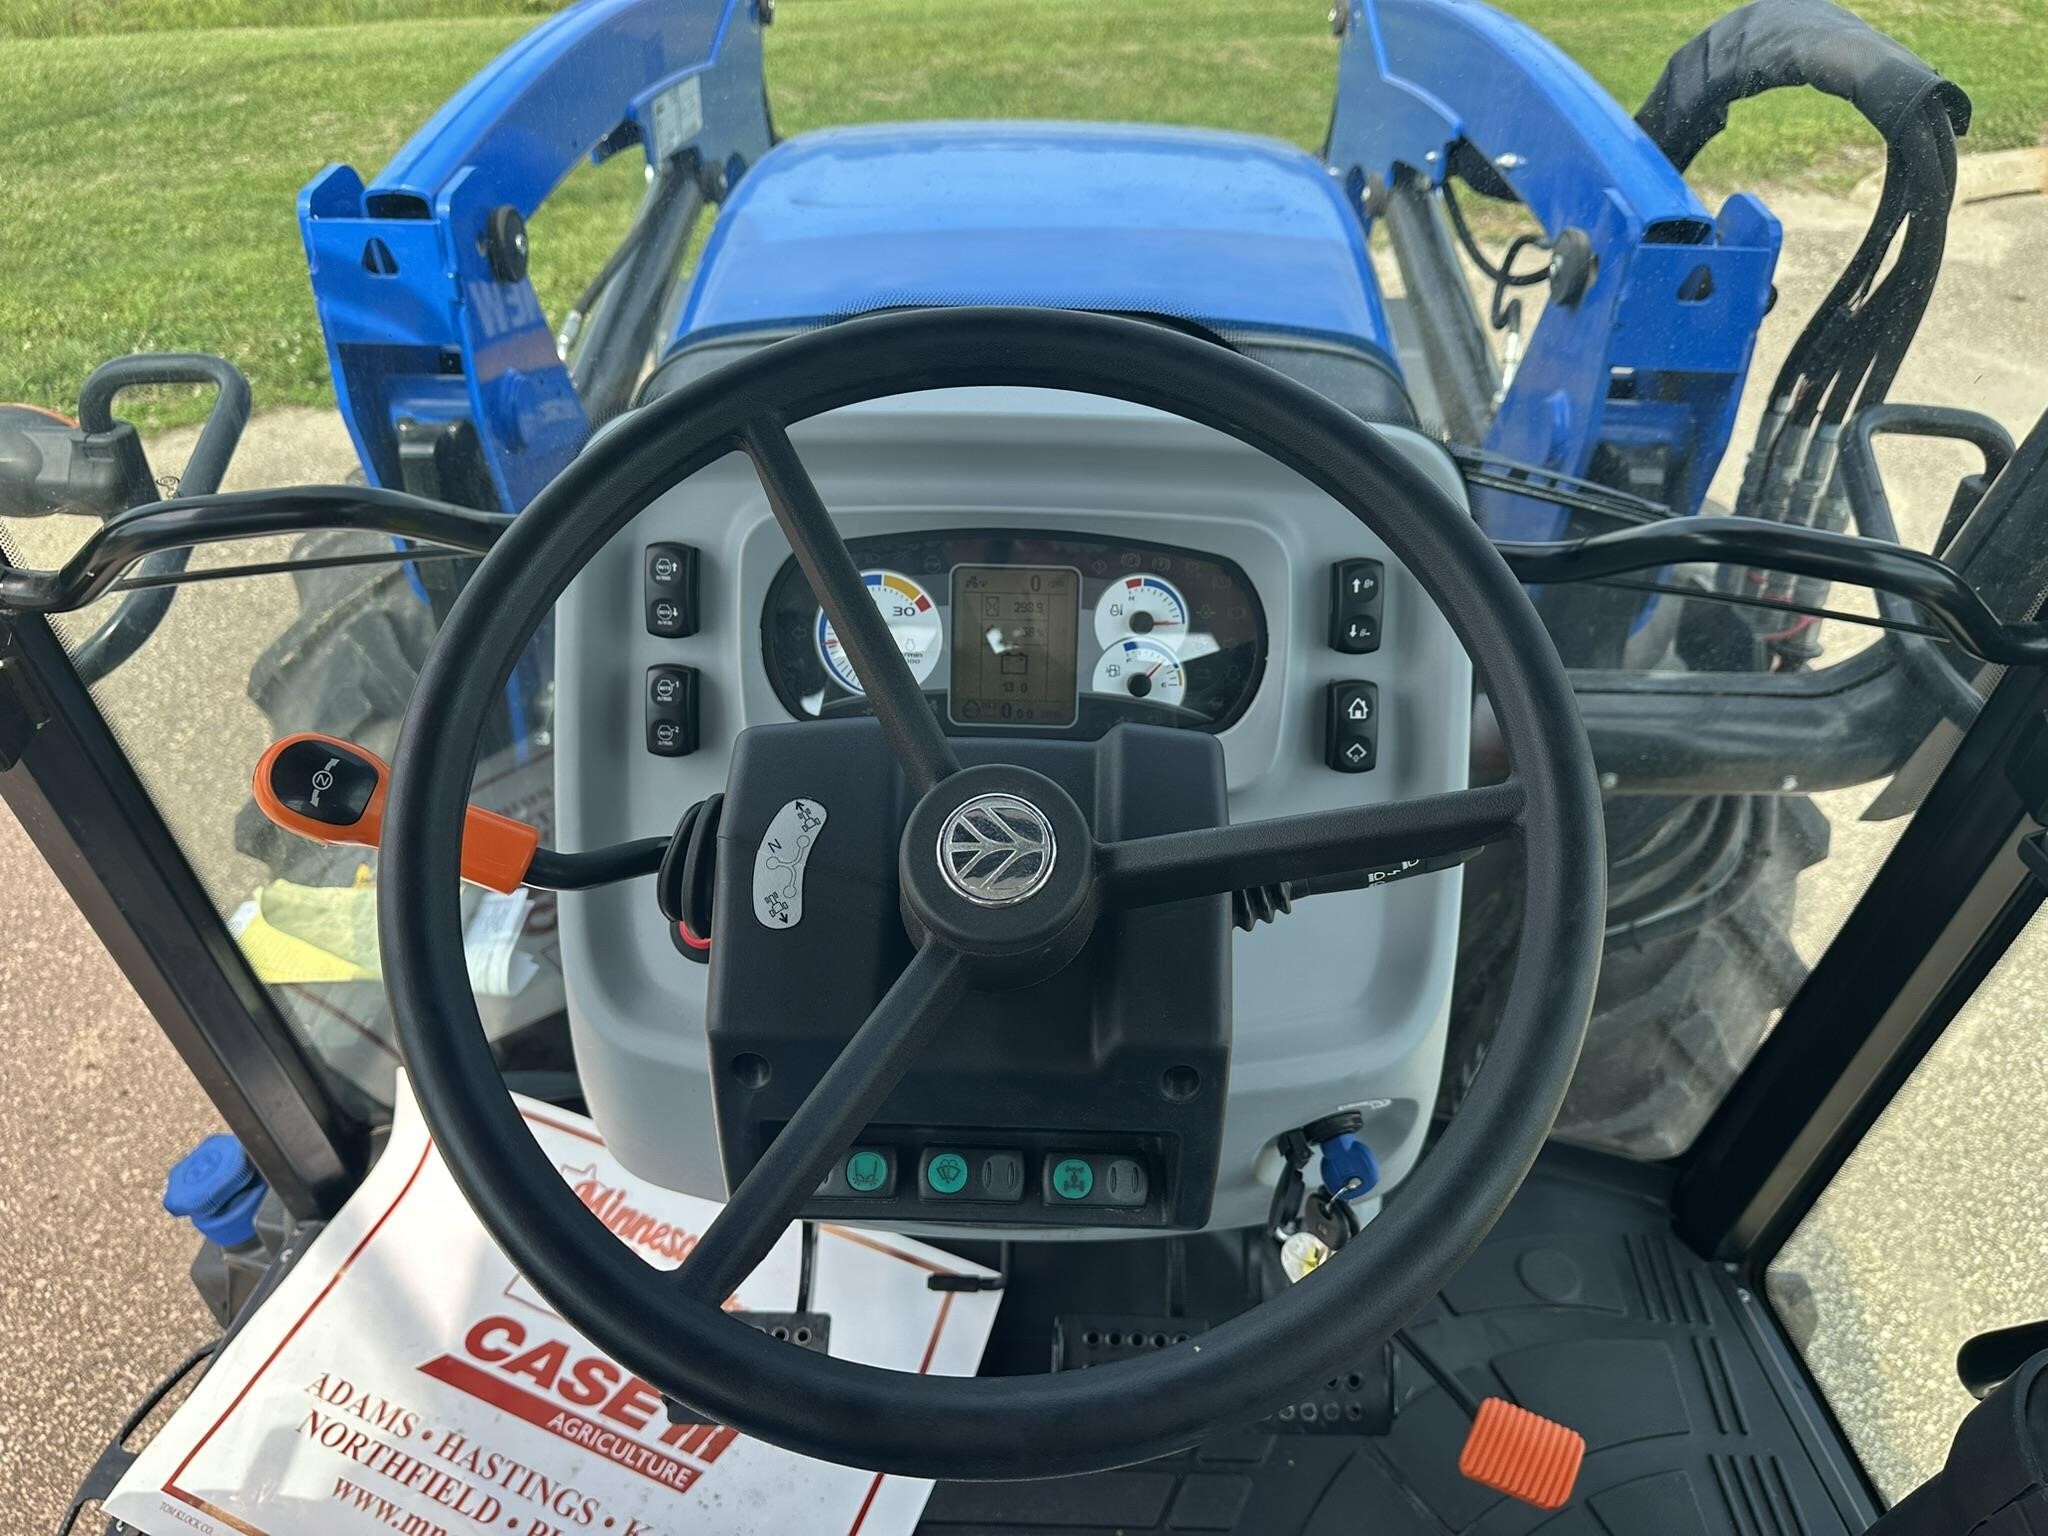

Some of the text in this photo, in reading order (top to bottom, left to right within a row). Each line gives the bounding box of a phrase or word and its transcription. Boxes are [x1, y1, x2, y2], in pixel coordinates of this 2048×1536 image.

[892, 605, 917, 617] 30
[315, 773, 330, 787] N
[767, 838, 783, 854] N
[464, 1314, 663, 1432] CASE
[295, 1407, 503, 1525] NORTHFIELD
[304, 1372, 420, 1441] ADAMS
[433, 1428, 601, 1527] HASTINGS
[547, 1411, 692, 1490] AGRICULTURE
